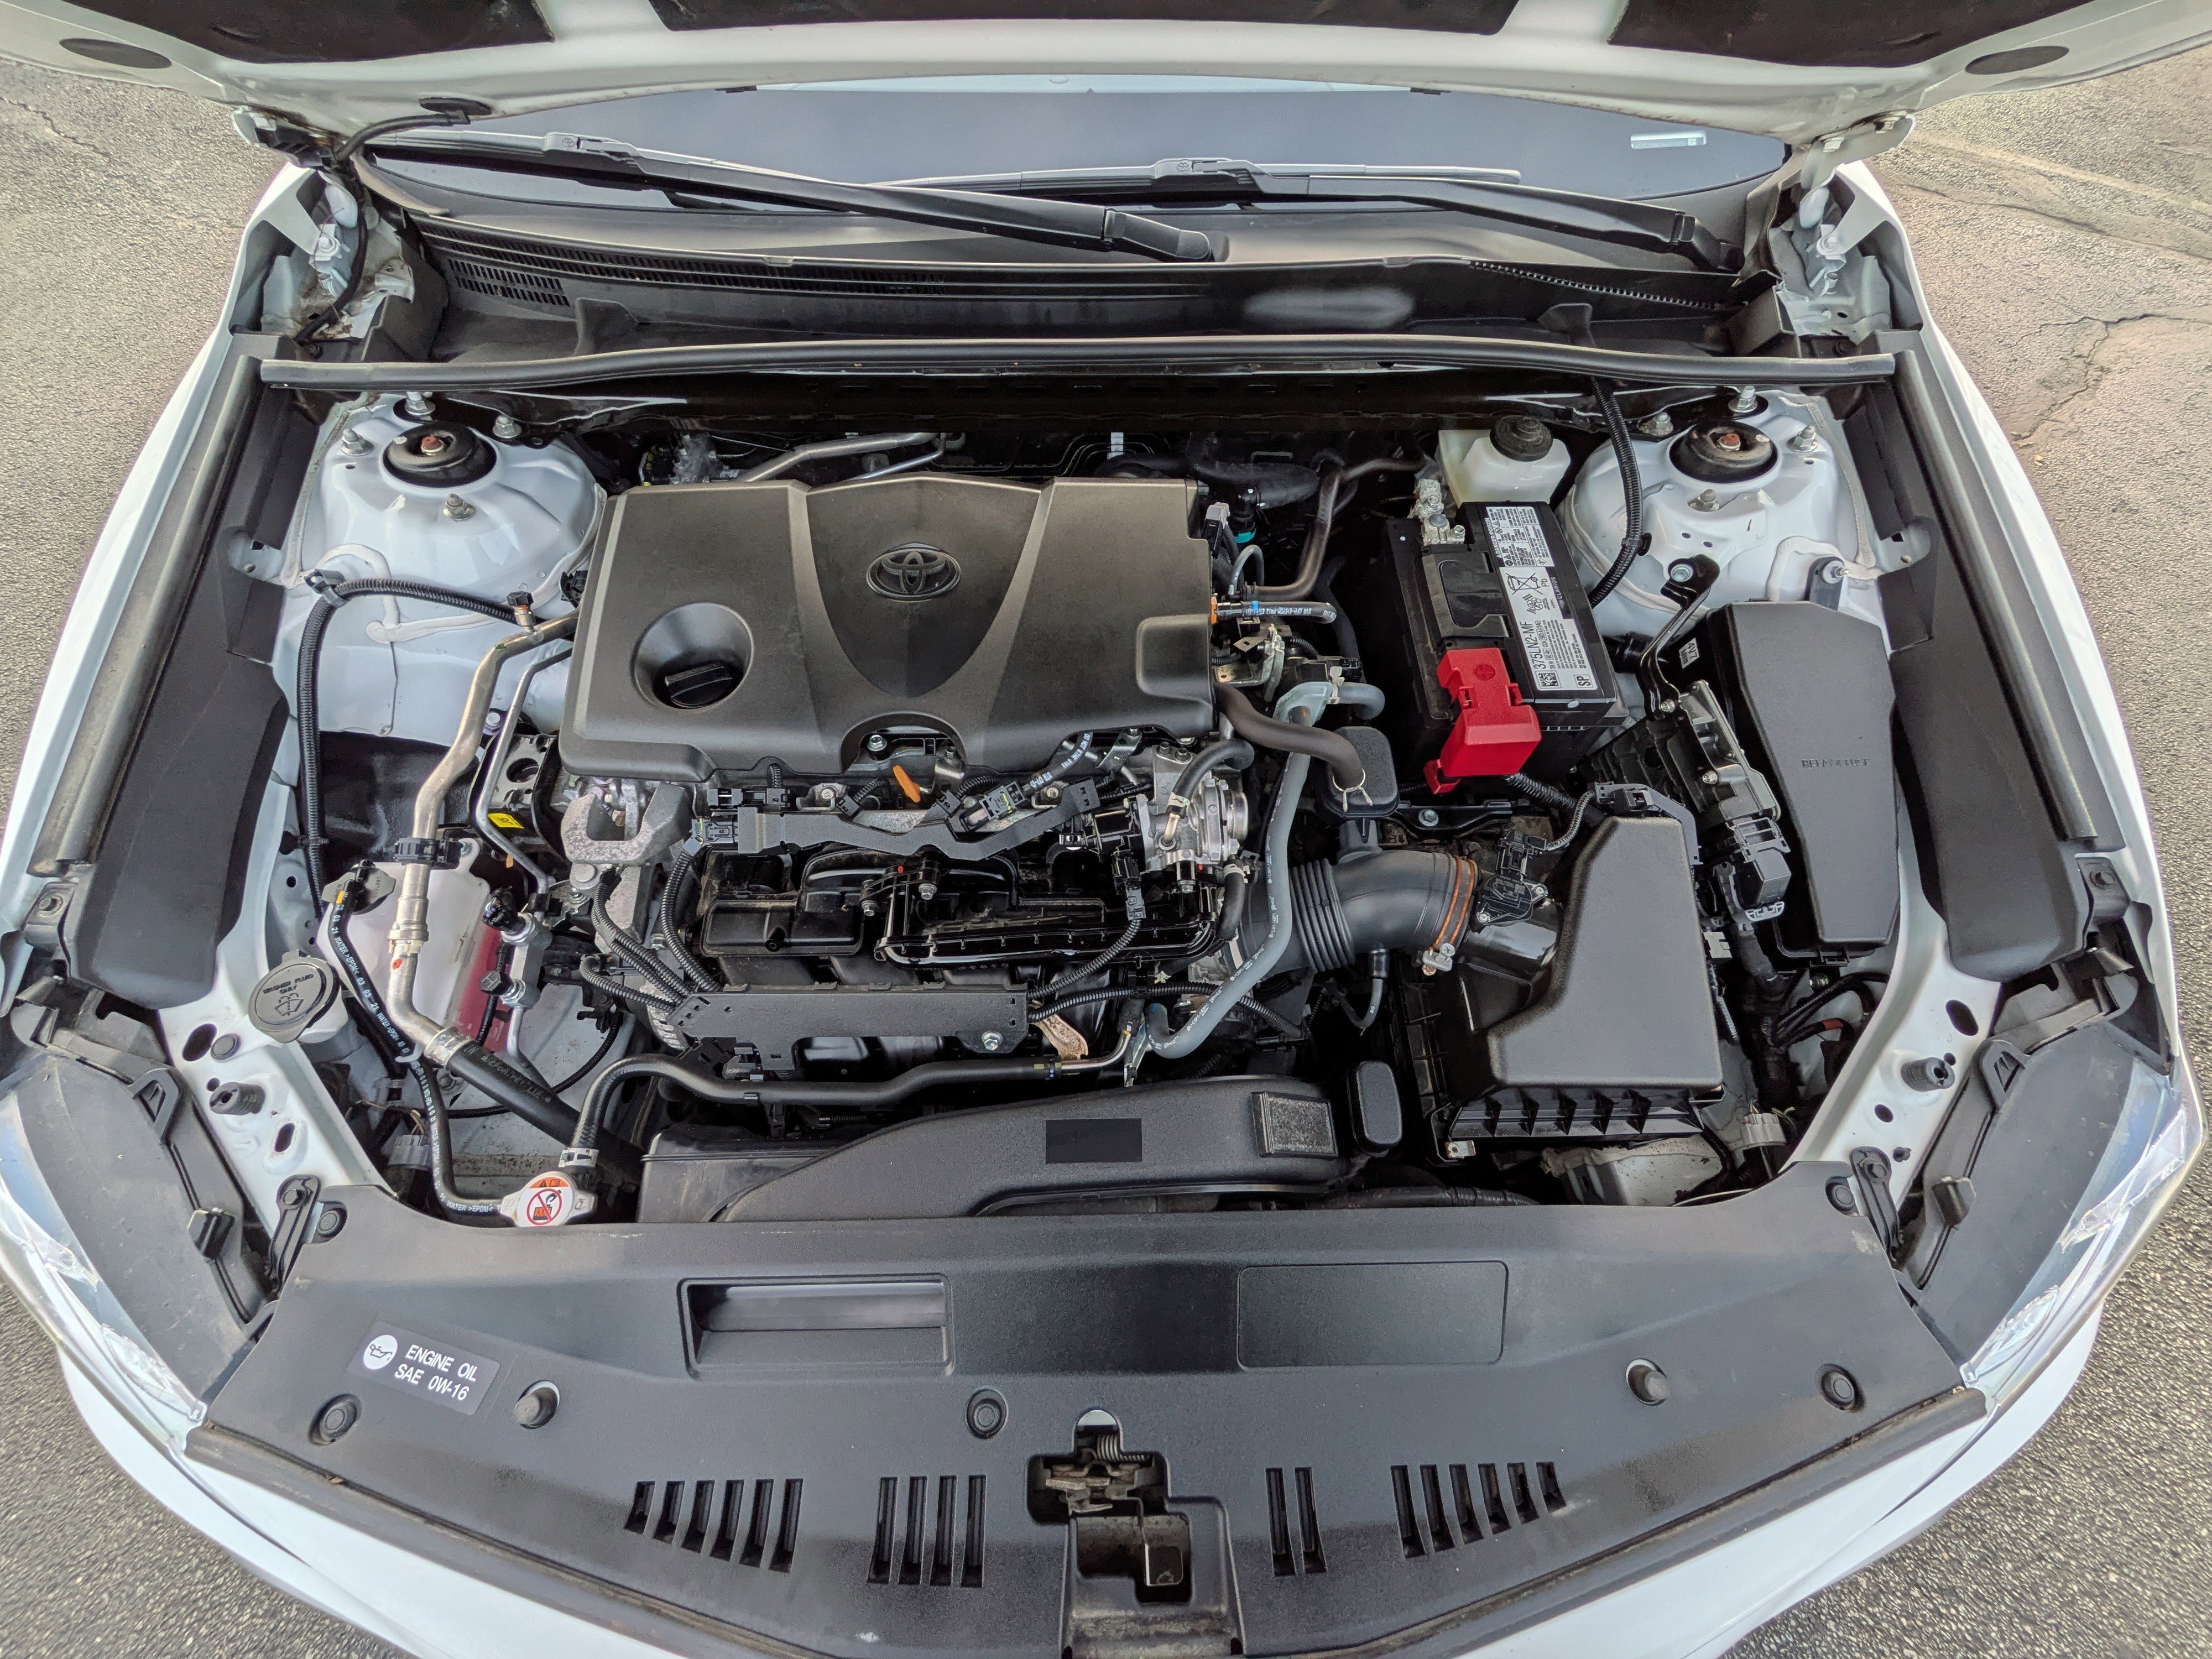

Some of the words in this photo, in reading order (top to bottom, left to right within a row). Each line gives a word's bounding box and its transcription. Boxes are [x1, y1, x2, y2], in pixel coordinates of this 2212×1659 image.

[1540, 578, 1550, 586] Pb
[1551, 576, 1563, 599] CLARIOS
[1519, 620, 1546, 669] 375LN2-MF
[1687, 643, 1697, 659] 4V7
[1575, 675, 1591, 686] SP
[335, 936, 348, 953] WATER
[346, 953, 359, 974] >EPDM<
[357, 977, 365, 985] 03
[363, 989, 372, 998] 03
[377, 1011, 390, 1028] WATER
[446, 1200, 467, 1212] WATER
[468, 1203, 493, 1212] >EPDM<
[405, 1344, 455, 1371] ENGINE
[458, 1363, 477, 1382] OIL
[394, 1363, 424, 1384] SAE
[428, 1375, 469, 1401] 0W-16
